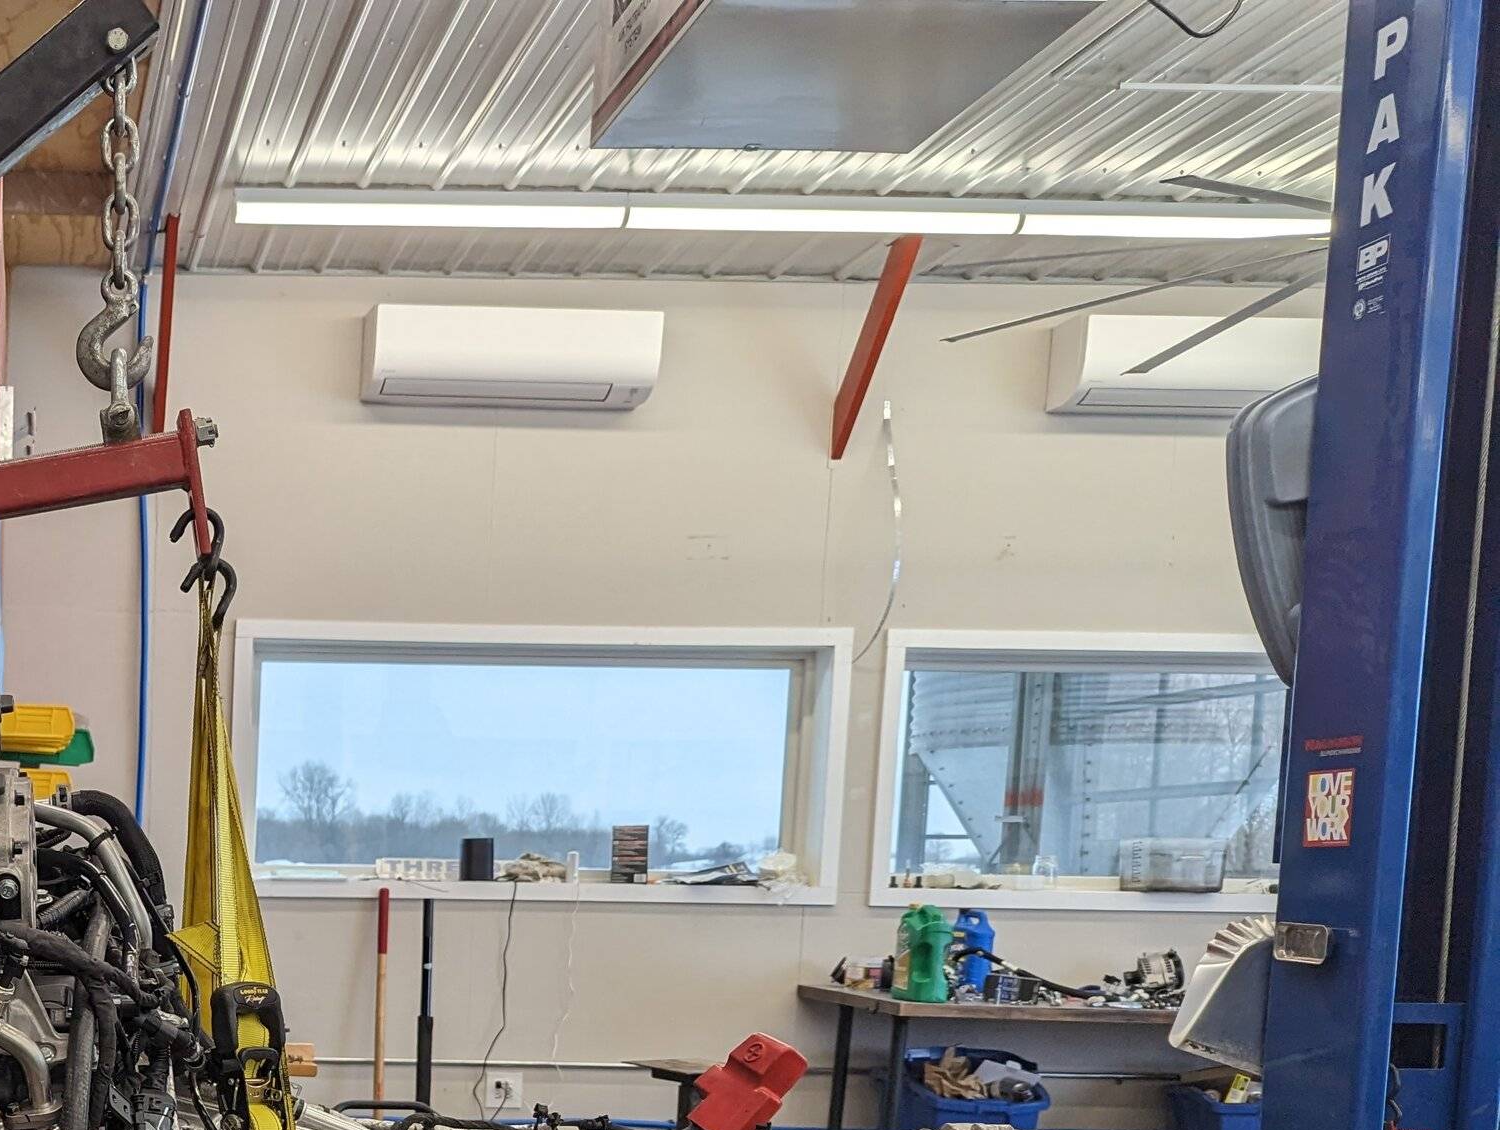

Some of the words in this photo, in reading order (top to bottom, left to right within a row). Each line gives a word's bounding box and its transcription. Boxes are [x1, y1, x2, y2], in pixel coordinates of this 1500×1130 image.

[1308, 771, 1353, 797] LOVE
[1307, 794, 1350, 819] YOUR
[1306, 817, 1348, 841] WORK
